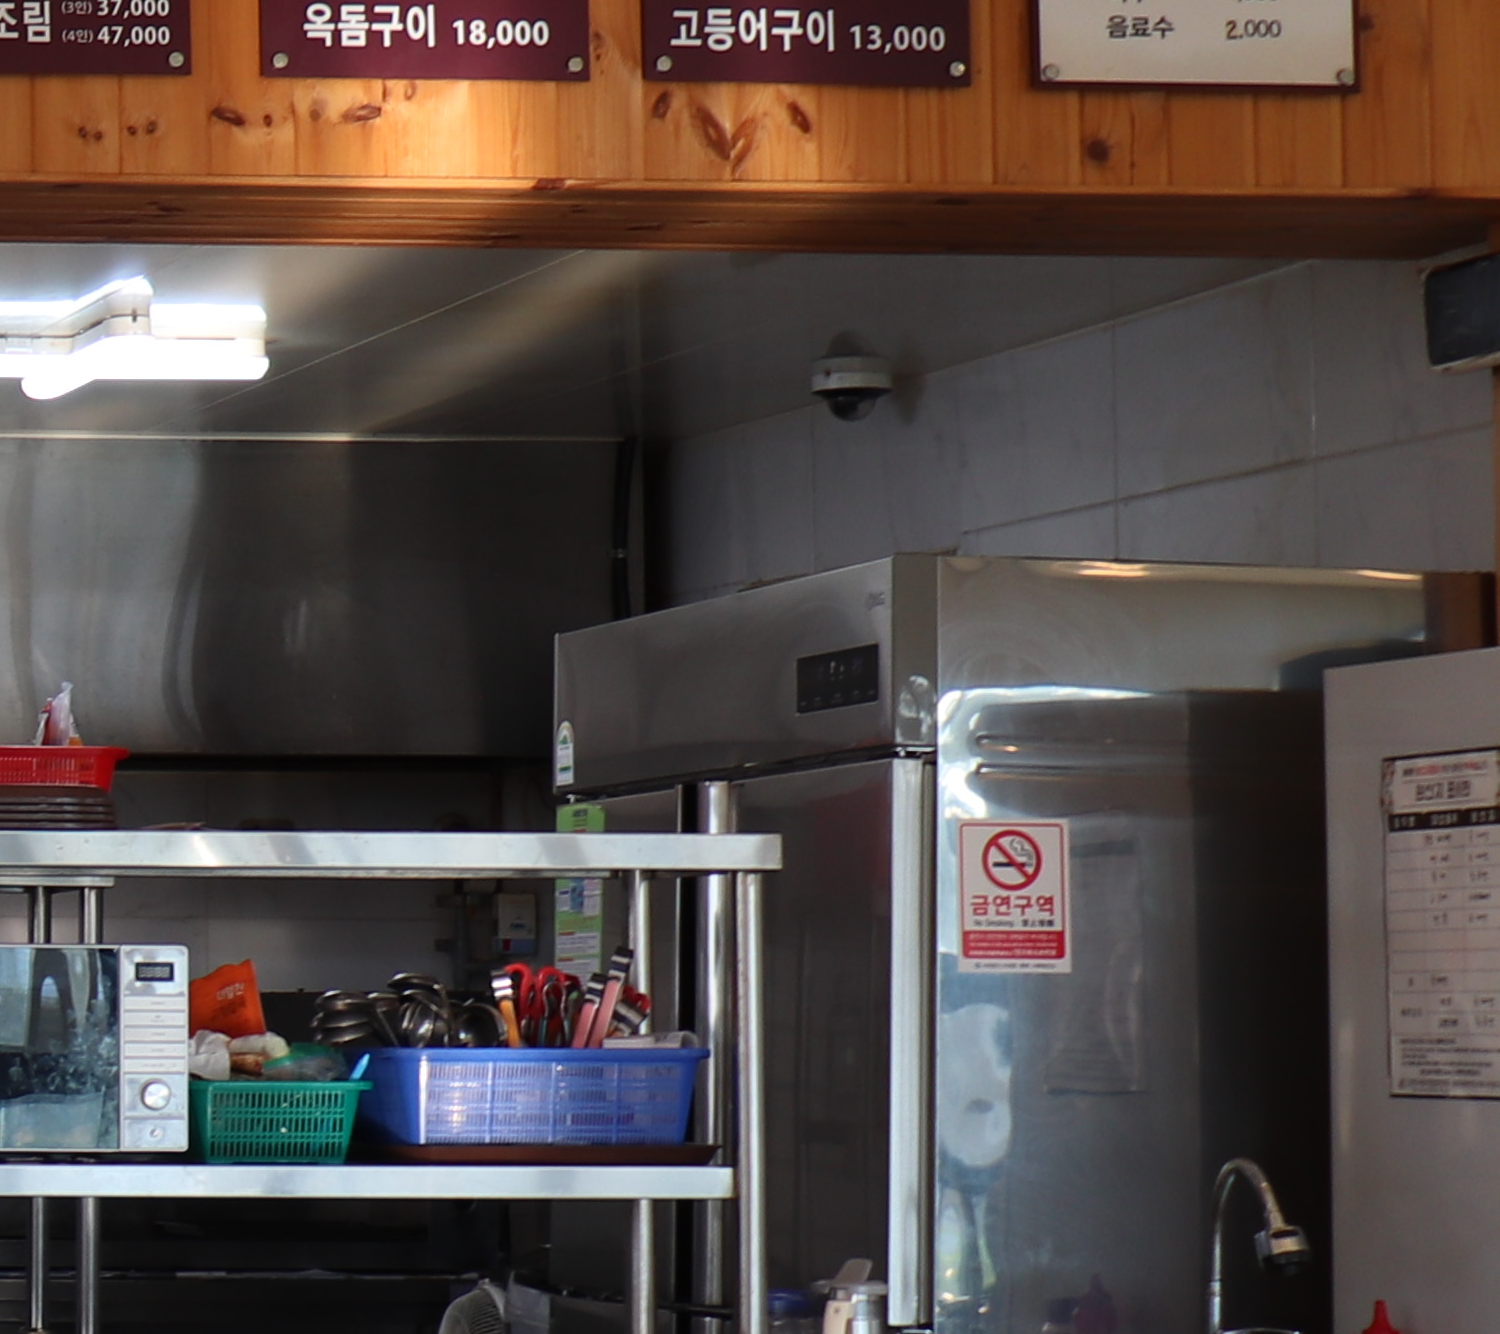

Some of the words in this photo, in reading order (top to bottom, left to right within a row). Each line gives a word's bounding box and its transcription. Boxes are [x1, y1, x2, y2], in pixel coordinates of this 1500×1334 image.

[60, 0, 93, 16] (3인)
[60, 27, 93, 44] (4인)
[96, 25, 170, 48] 47,000
[302, 2, 436, 48] 옥돔구이
[452, 20, 550, 49] 18,000
[669, 9, 836, 53] 고등어구이
[848, 25, 946, 54] 13,000
[1106, 16, 1175, 39] 음료수
[970, 895, 1055, 916] 금연구역
